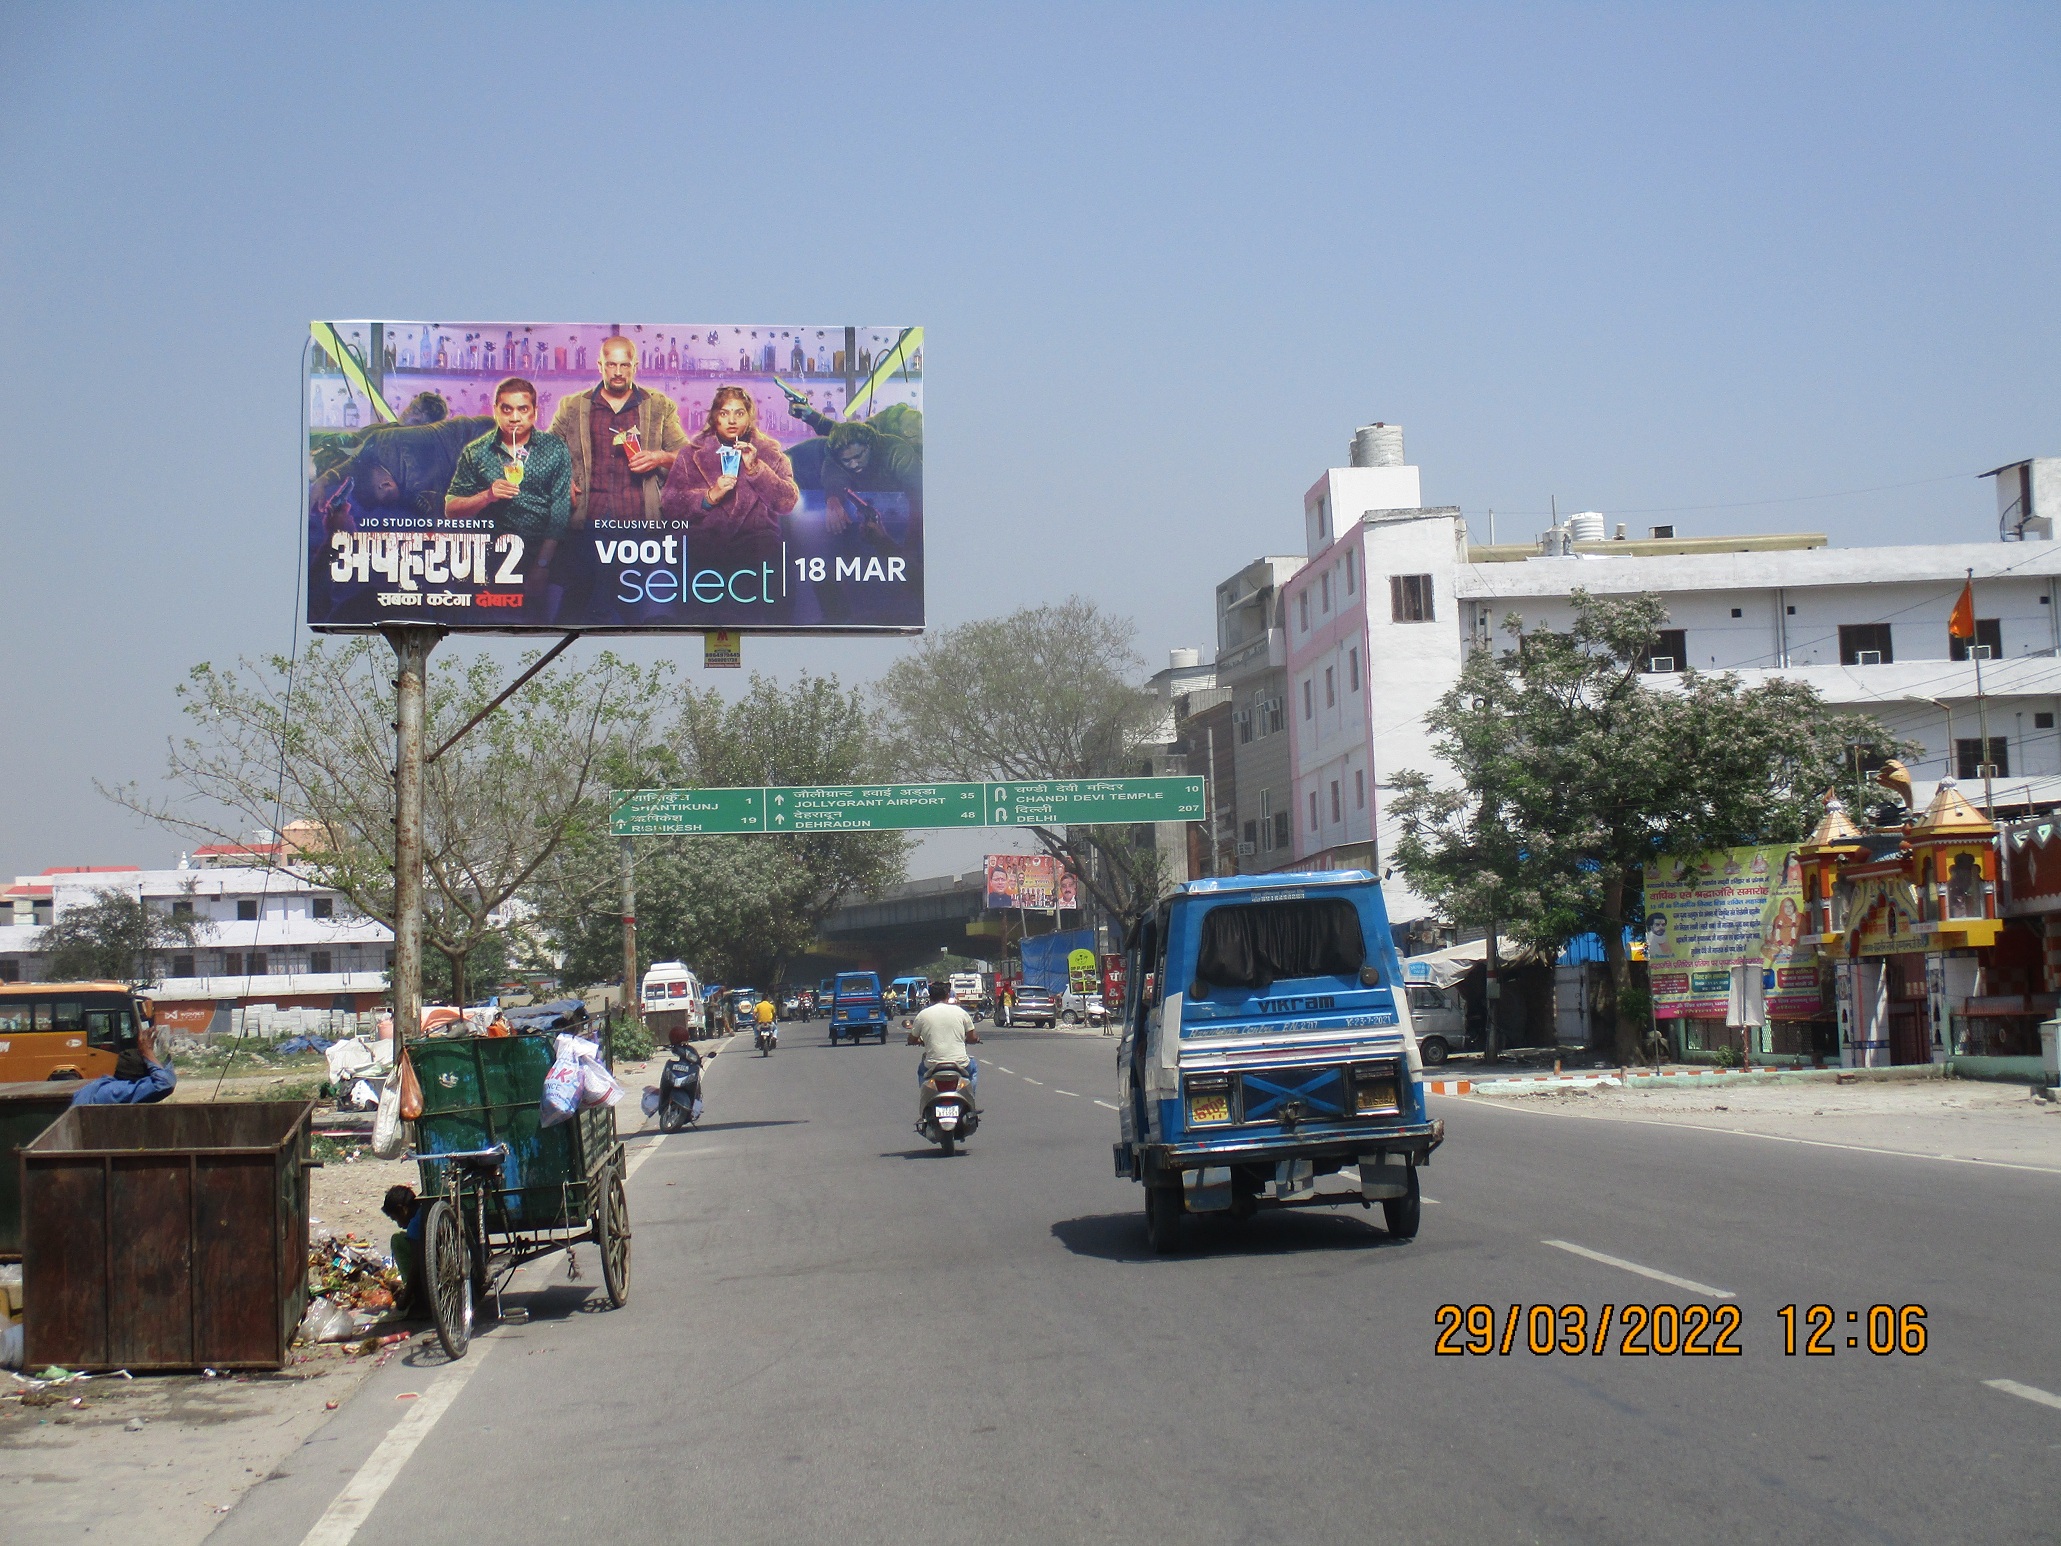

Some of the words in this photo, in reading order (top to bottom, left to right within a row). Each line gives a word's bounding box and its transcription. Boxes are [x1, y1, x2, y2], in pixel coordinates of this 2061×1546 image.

[360, 518, 379, 527] JIO
[382, 518, 433, 528] STUDIOS
[437, 519, 495, 529] PRESENTS
[594, 519, 667, 530] EXCLUSIVELY
[671, 520, 689, 529] ON
[595, 534, 678, 564] voot
[330, 530, 491, 591] अपहरण
[495, 533, 525, 584] 2
[617, 534, 774, 603] select
[795, 556, 826, 582] 18
[835, 556, 906, 582] MAR
[377, 591, 422, 607] सबका
[427, 590, 471, 607] कटेगा
[475, 590, 523, 608] दोबारा
[1014, 783, 1048, 793] चण्डी
[1055, 782, 1079, 793] देवी
[1086, 781, 1124, 791] मन्दिर
[1185, 785, 1199, 793] 10
[862, 788, 892, 798] हवाई
[960, 792, 975, 800] 35
[1016, 795, 1068, 803] CHANDI
[1073, 794, 1104, 802] DEVI
[1109, 792, 1164, 801] TEMPLE
[794, 799, 883, 808] JOLLYGRANT
[887, 797, 946, 806] AIRPORT
[1015, 804, 1052, 814] दिल्ली
[1178, 804, 1200, 812] 207
[793, 810, 842, 820] देहरादून
[960, 811, 975, 819] 48
[1016, 814, 1057, 823] DELHI
[795, 820, 871, 829] DEHRADUN
